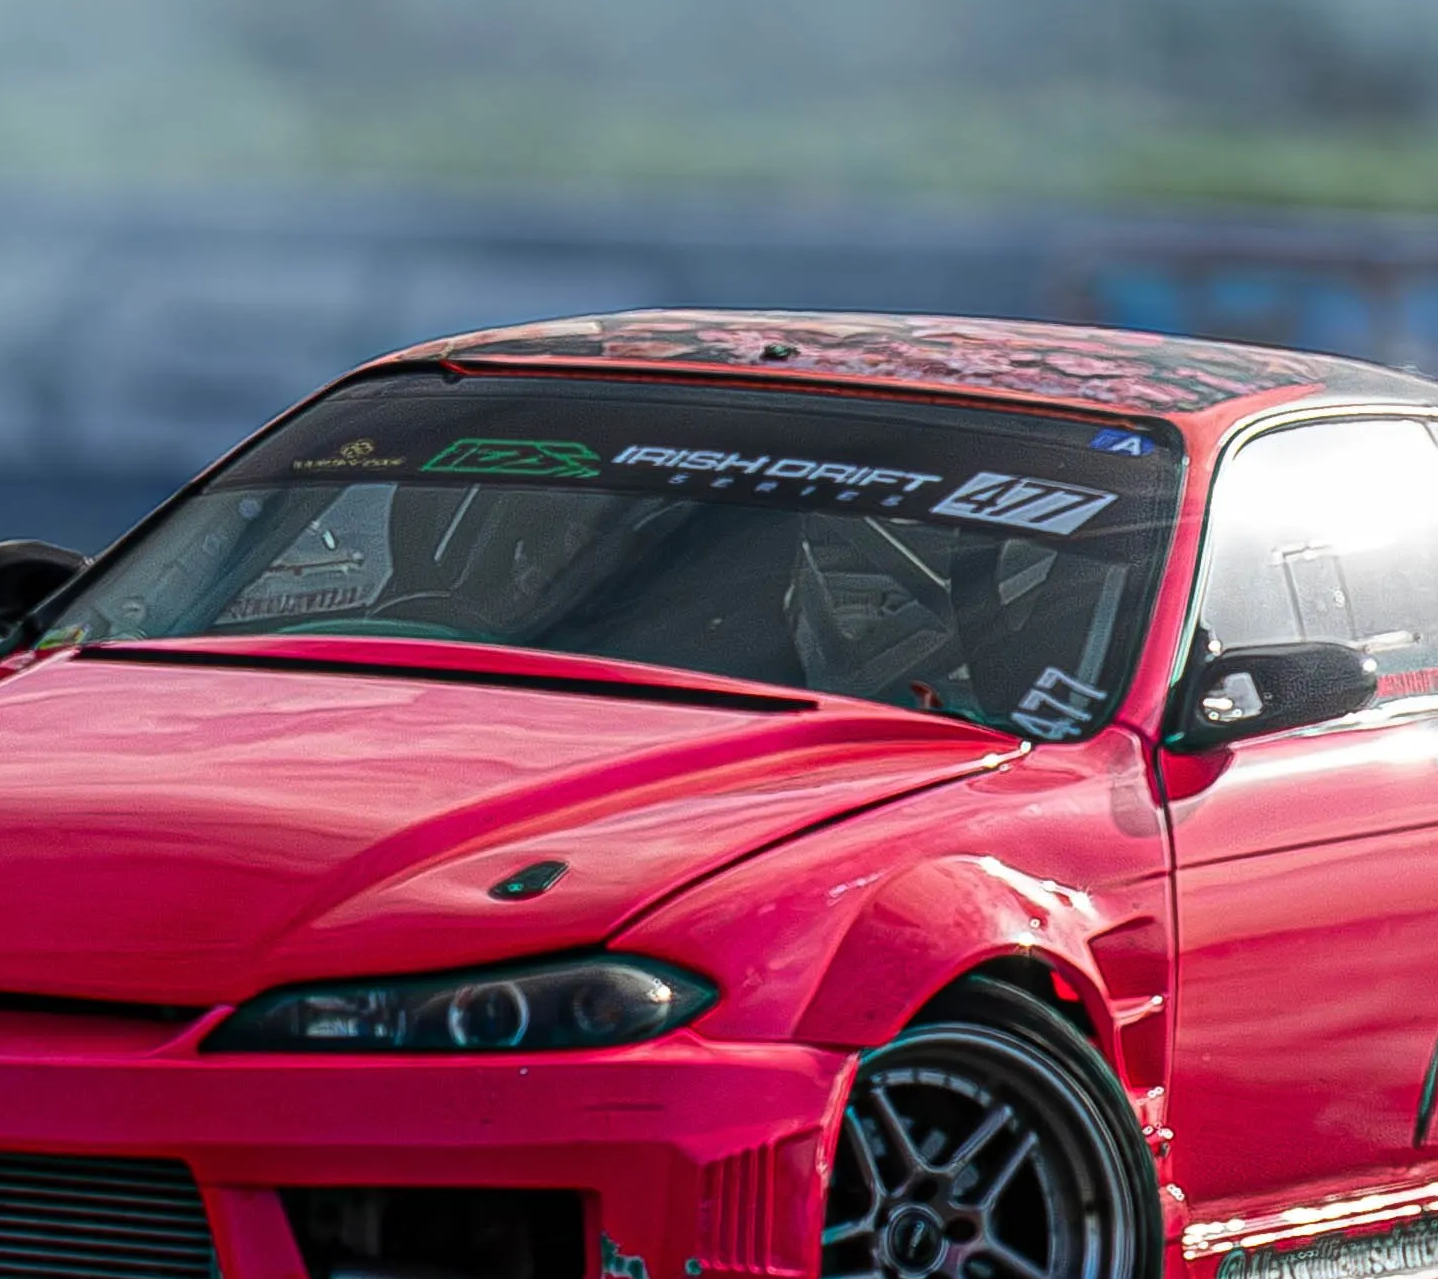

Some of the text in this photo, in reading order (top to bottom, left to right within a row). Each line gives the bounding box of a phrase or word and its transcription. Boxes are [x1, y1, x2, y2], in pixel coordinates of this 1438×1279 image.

[612, 445, 942, 492] IRISH DRIFT
[669, 473, 904, 507] SERIES
[952, 477, 1106, 524] 477
[1011, 666, 1107, 740] 477
